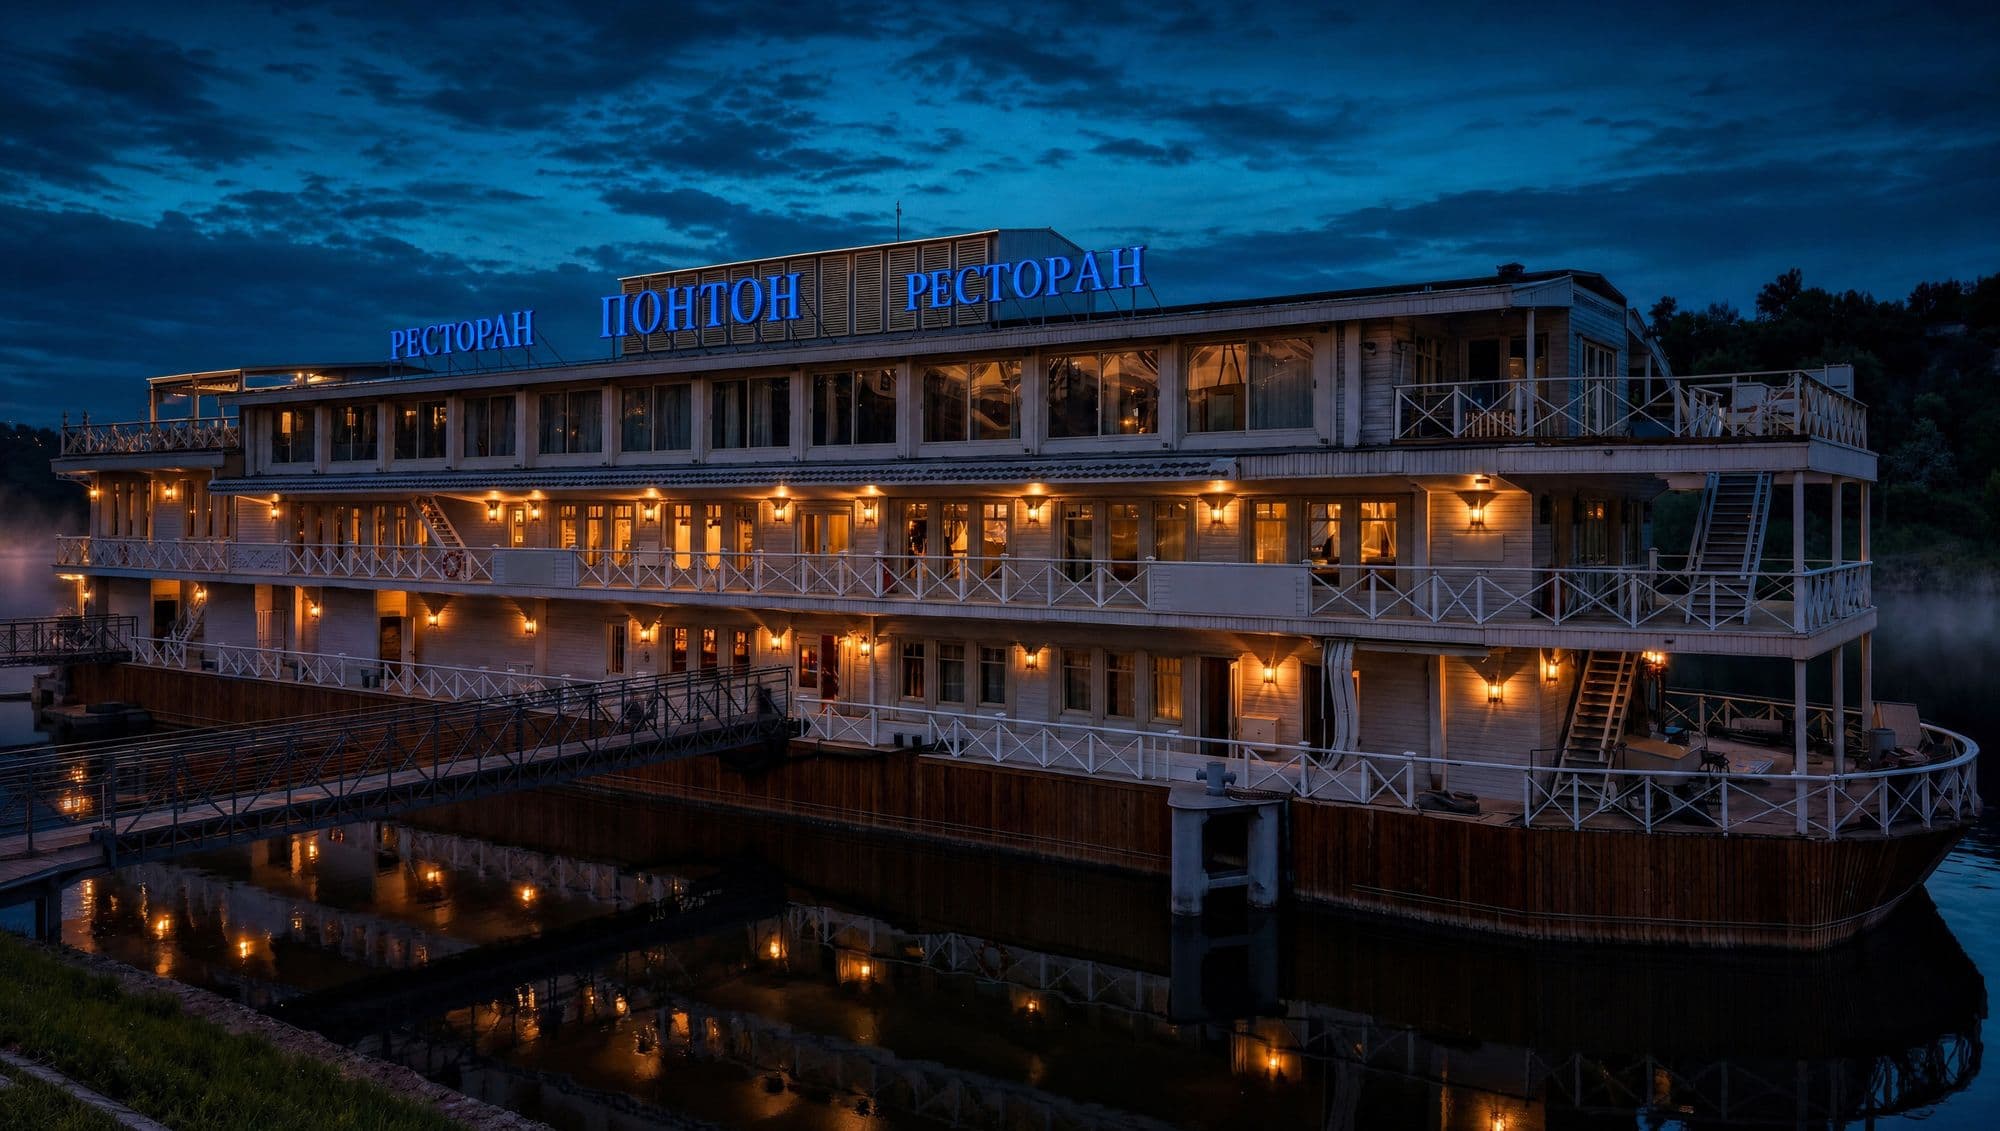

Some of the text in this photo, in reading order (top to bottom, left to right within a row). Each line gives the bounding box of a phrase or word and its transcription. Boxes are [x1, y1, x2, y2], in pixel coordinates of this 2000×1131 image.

[600, 273, 801, 338] ПОНТОН
[905, 245, 1146, 311] РЕСТОРАН
[390, 310, 534, 360] РЕСТОРАН
